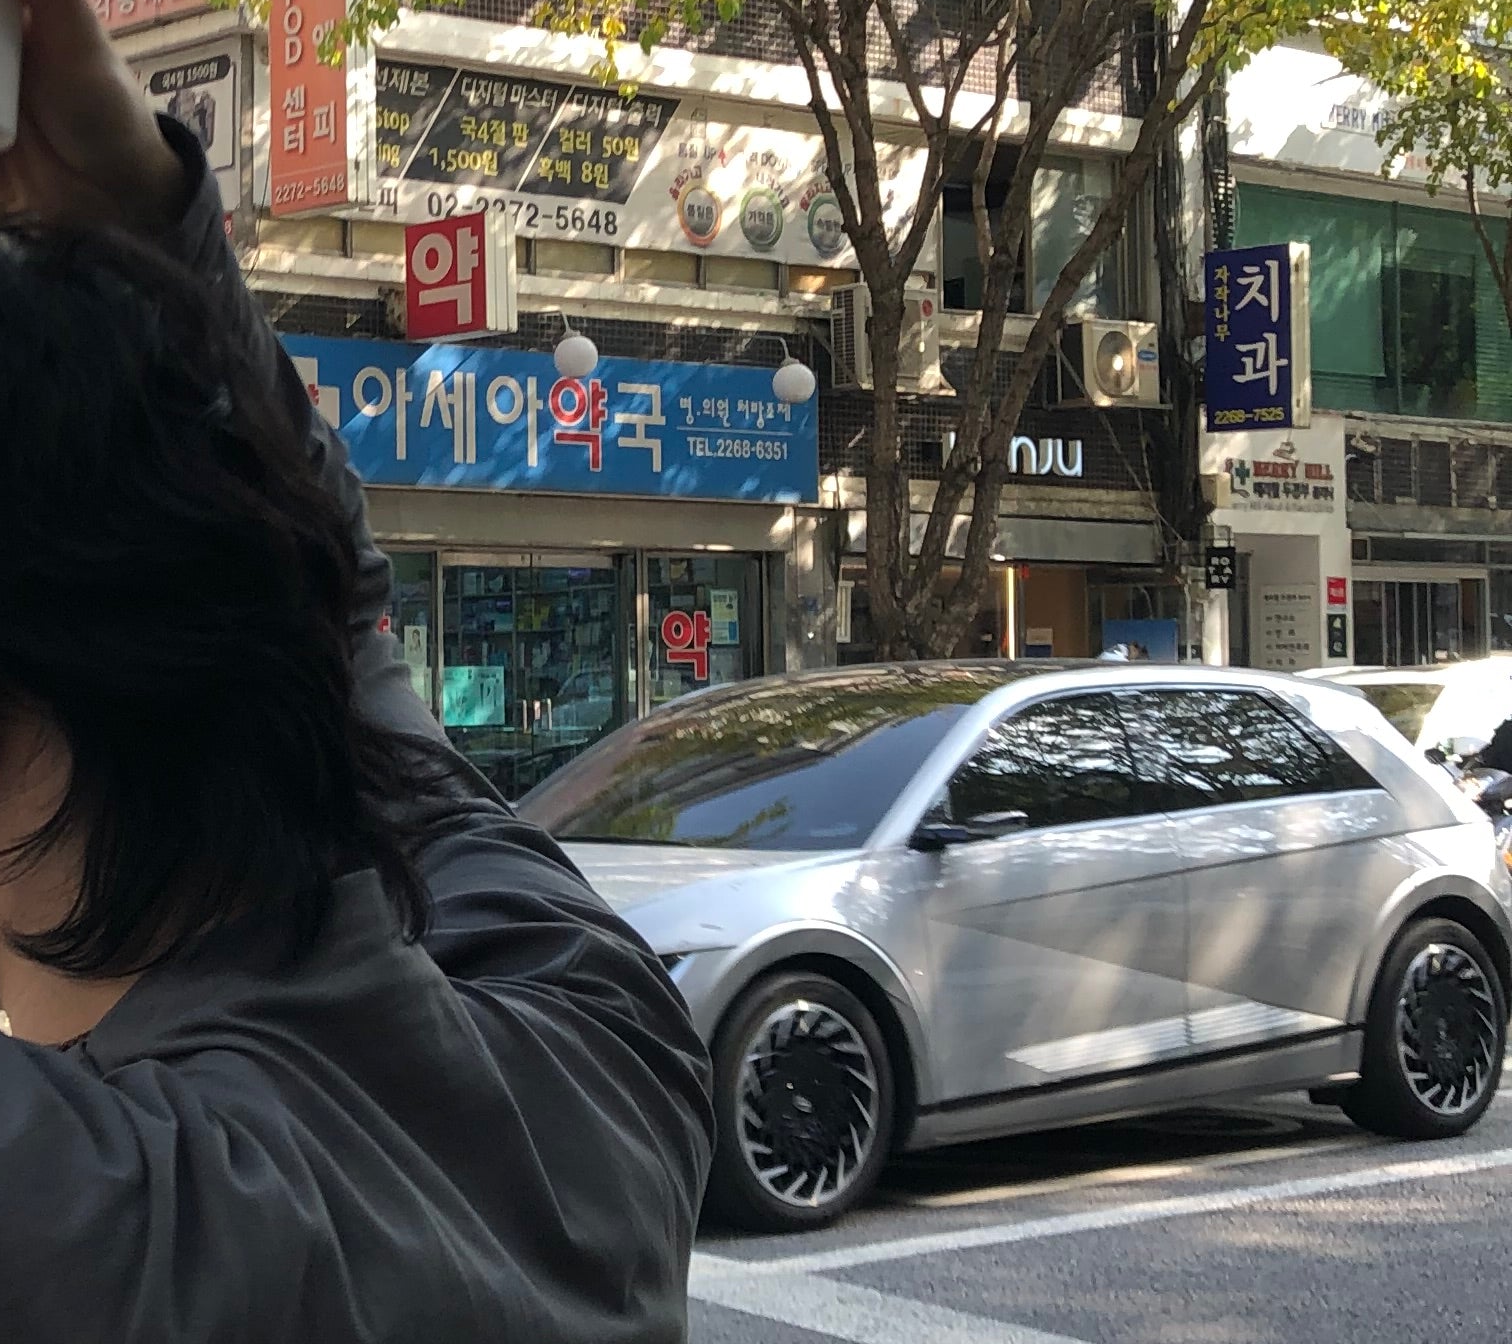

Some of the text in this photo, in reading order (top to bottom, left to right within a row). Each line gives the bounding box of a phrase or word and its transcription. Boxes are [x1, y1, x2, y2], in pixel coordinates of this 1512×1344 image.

[376, 138, 401, 169] ing
[428, 146, 499, 177] 1,500원
[602, 136, 639, 163] 50원
[275, 175, 345, 204] 2272-5648
[581, 162, 610, 190] 8원
[411, 226, 479, 325] 약
[1232, 259, 1289, 396] 치과
[353, 366, 666, 474] 아세아약국
[662, 610, 712, 681] 약
